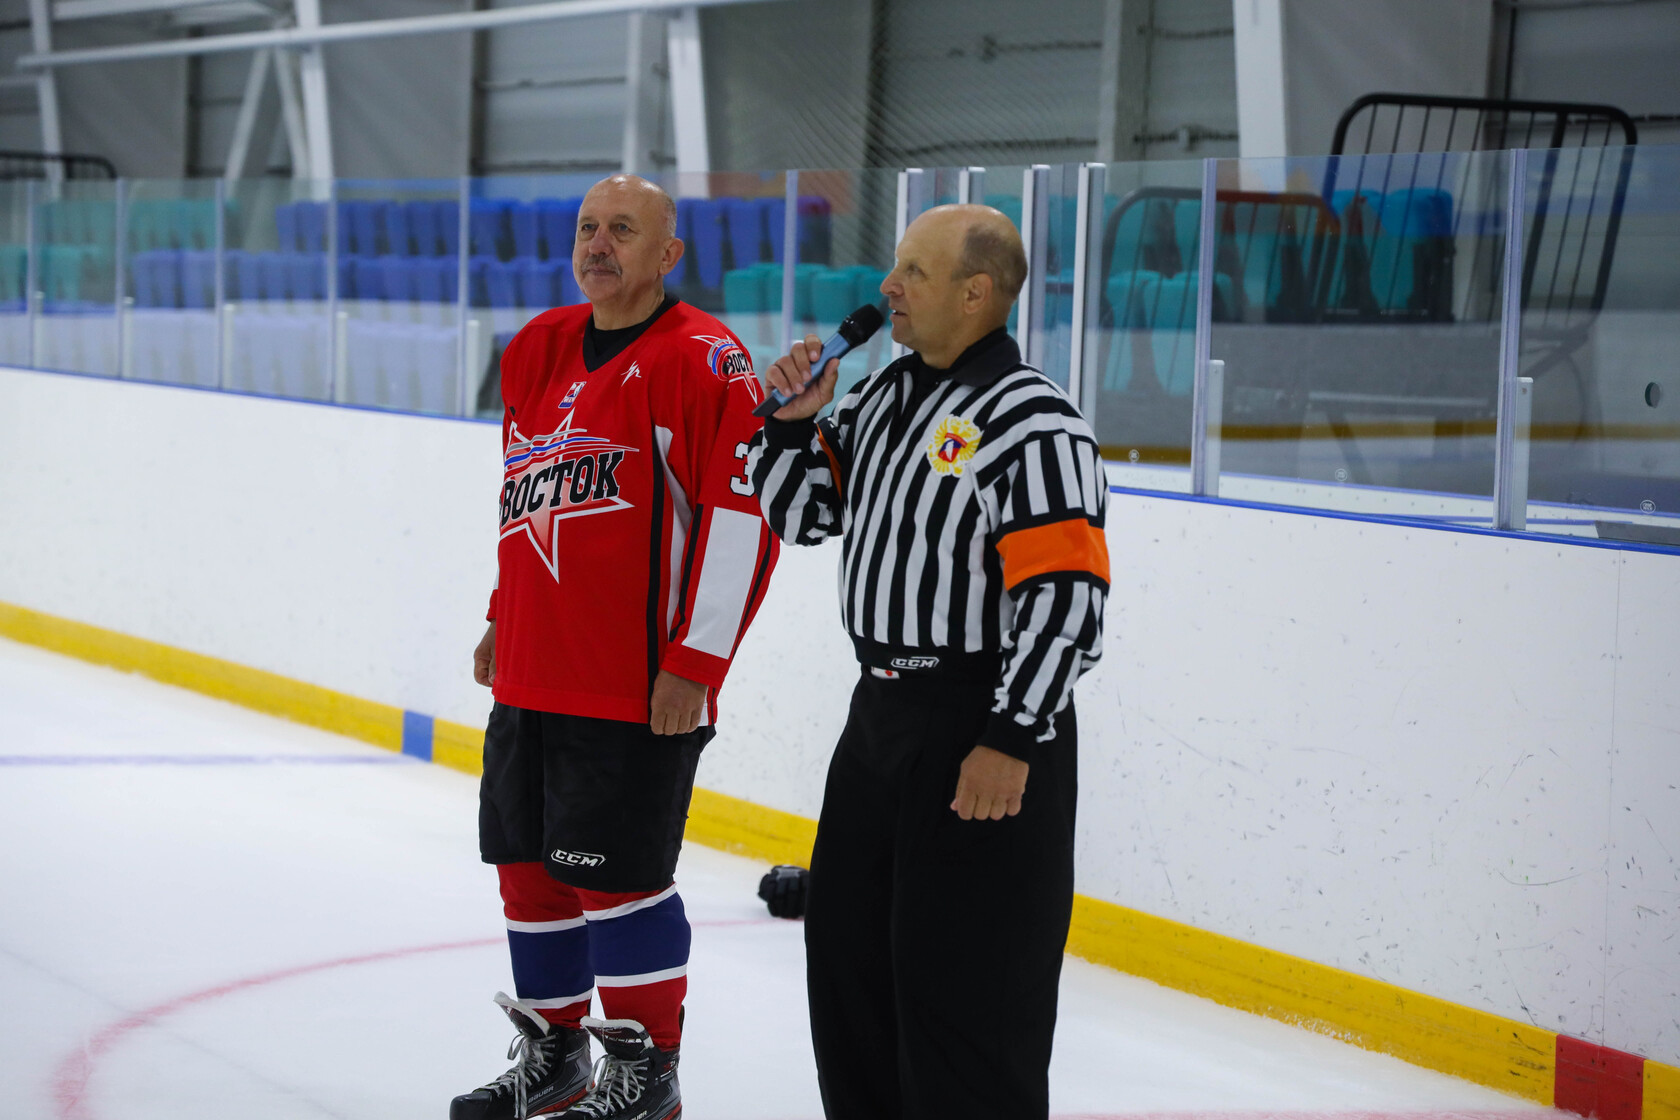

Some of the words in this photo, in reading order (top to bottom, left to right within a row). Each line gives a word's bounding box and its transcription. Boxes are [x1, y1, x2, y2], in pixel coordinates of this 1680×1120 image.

[500, 450, 624, 527] ВОСТОК
[895, 657, 935, 668] CCM
[555, 848, 598, 867] CCM
